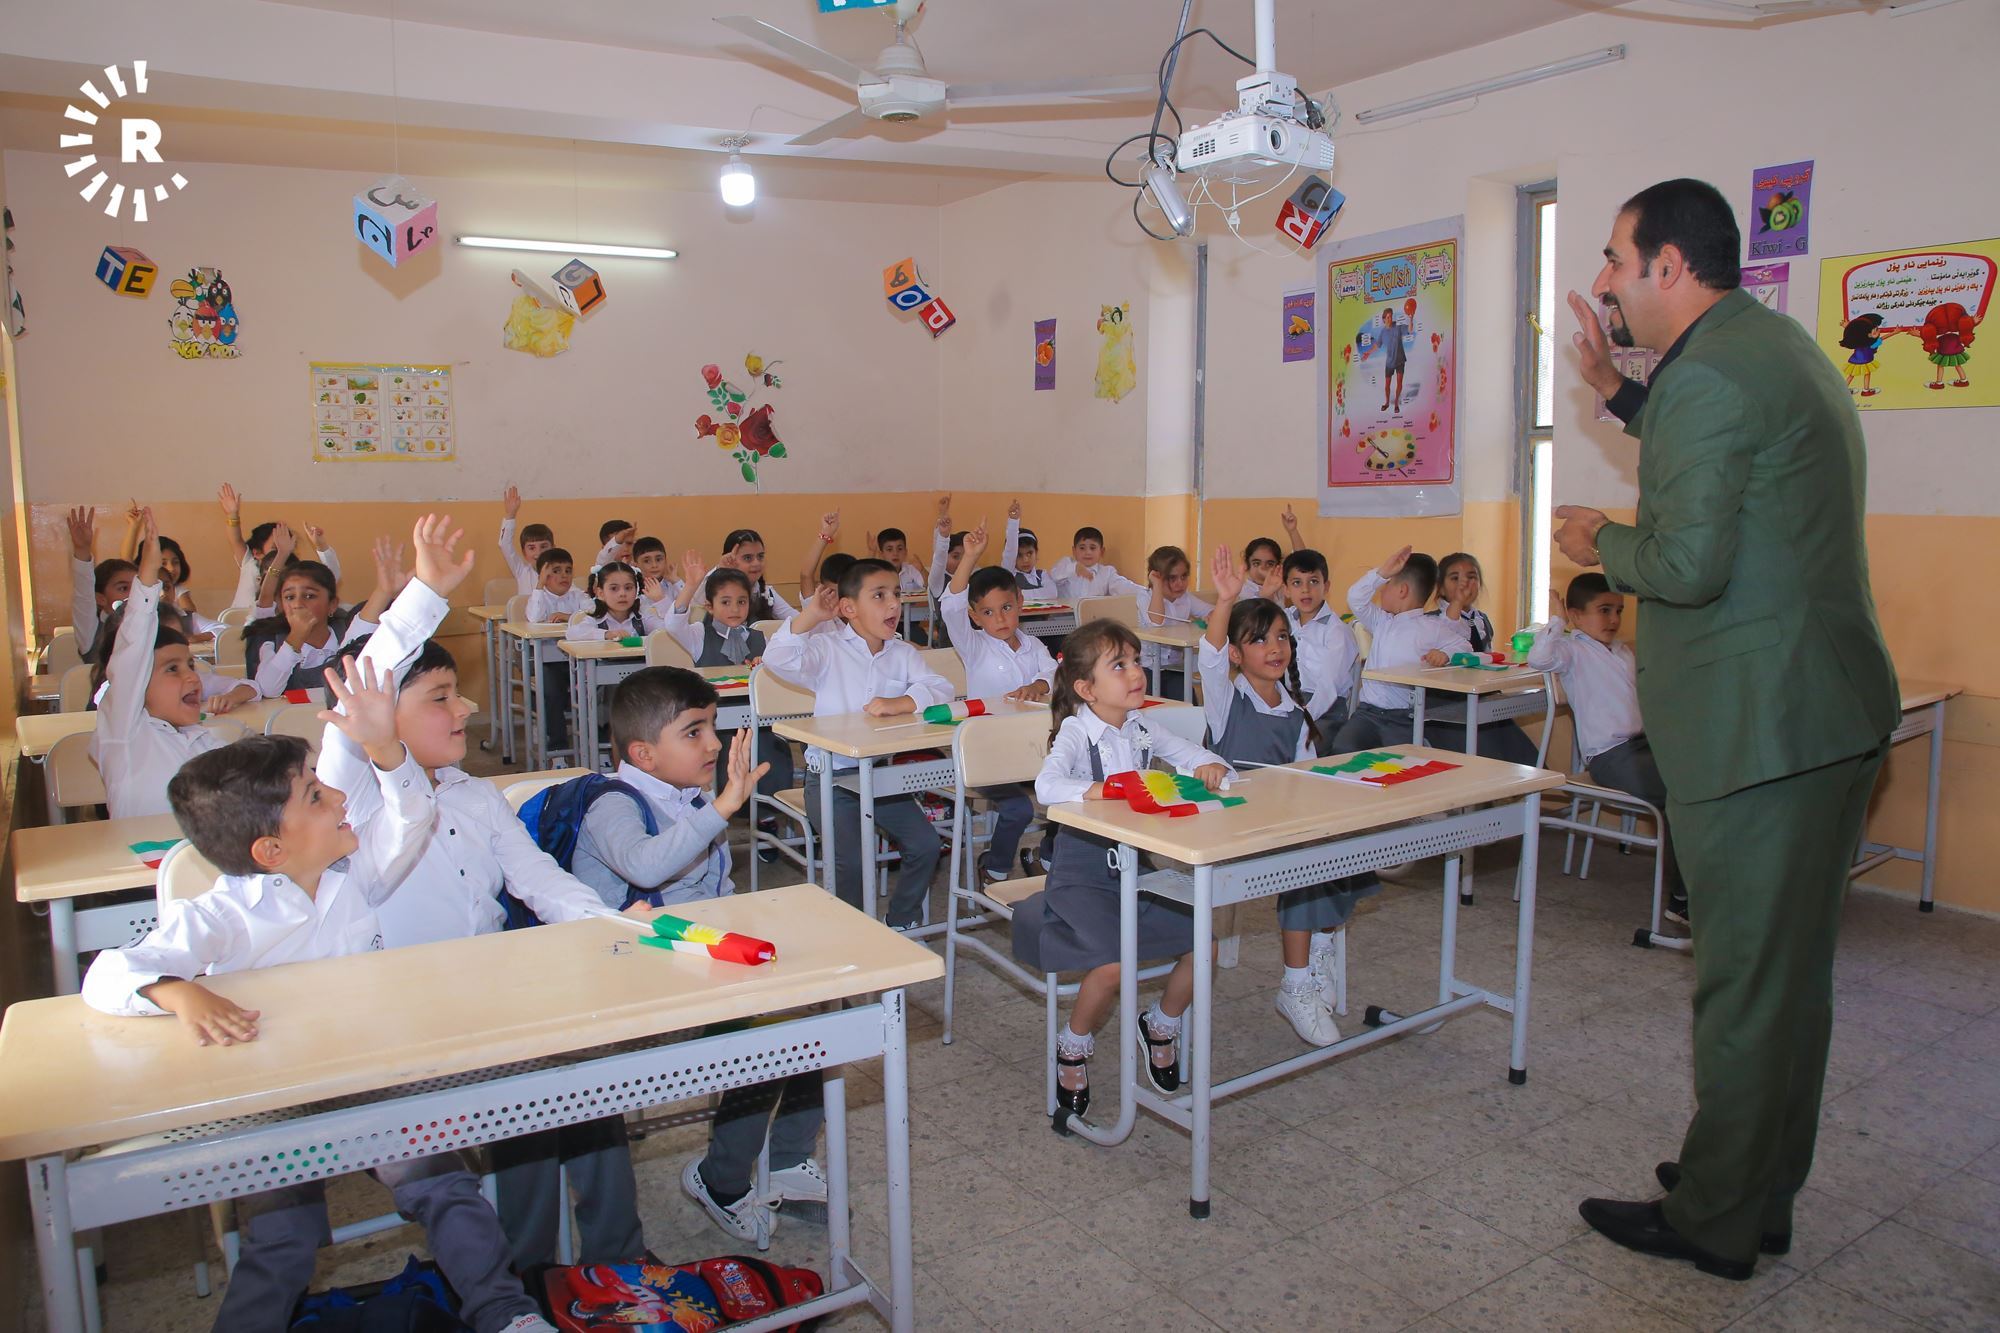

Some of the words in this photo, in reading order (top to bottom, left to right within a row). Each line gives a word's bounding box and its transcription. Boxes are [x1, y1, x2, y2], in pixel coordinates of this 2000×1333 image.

[103, 251, 125, 284] T
[124, 265, 154, 294] E
[1370, 262, 1412, 296] English
